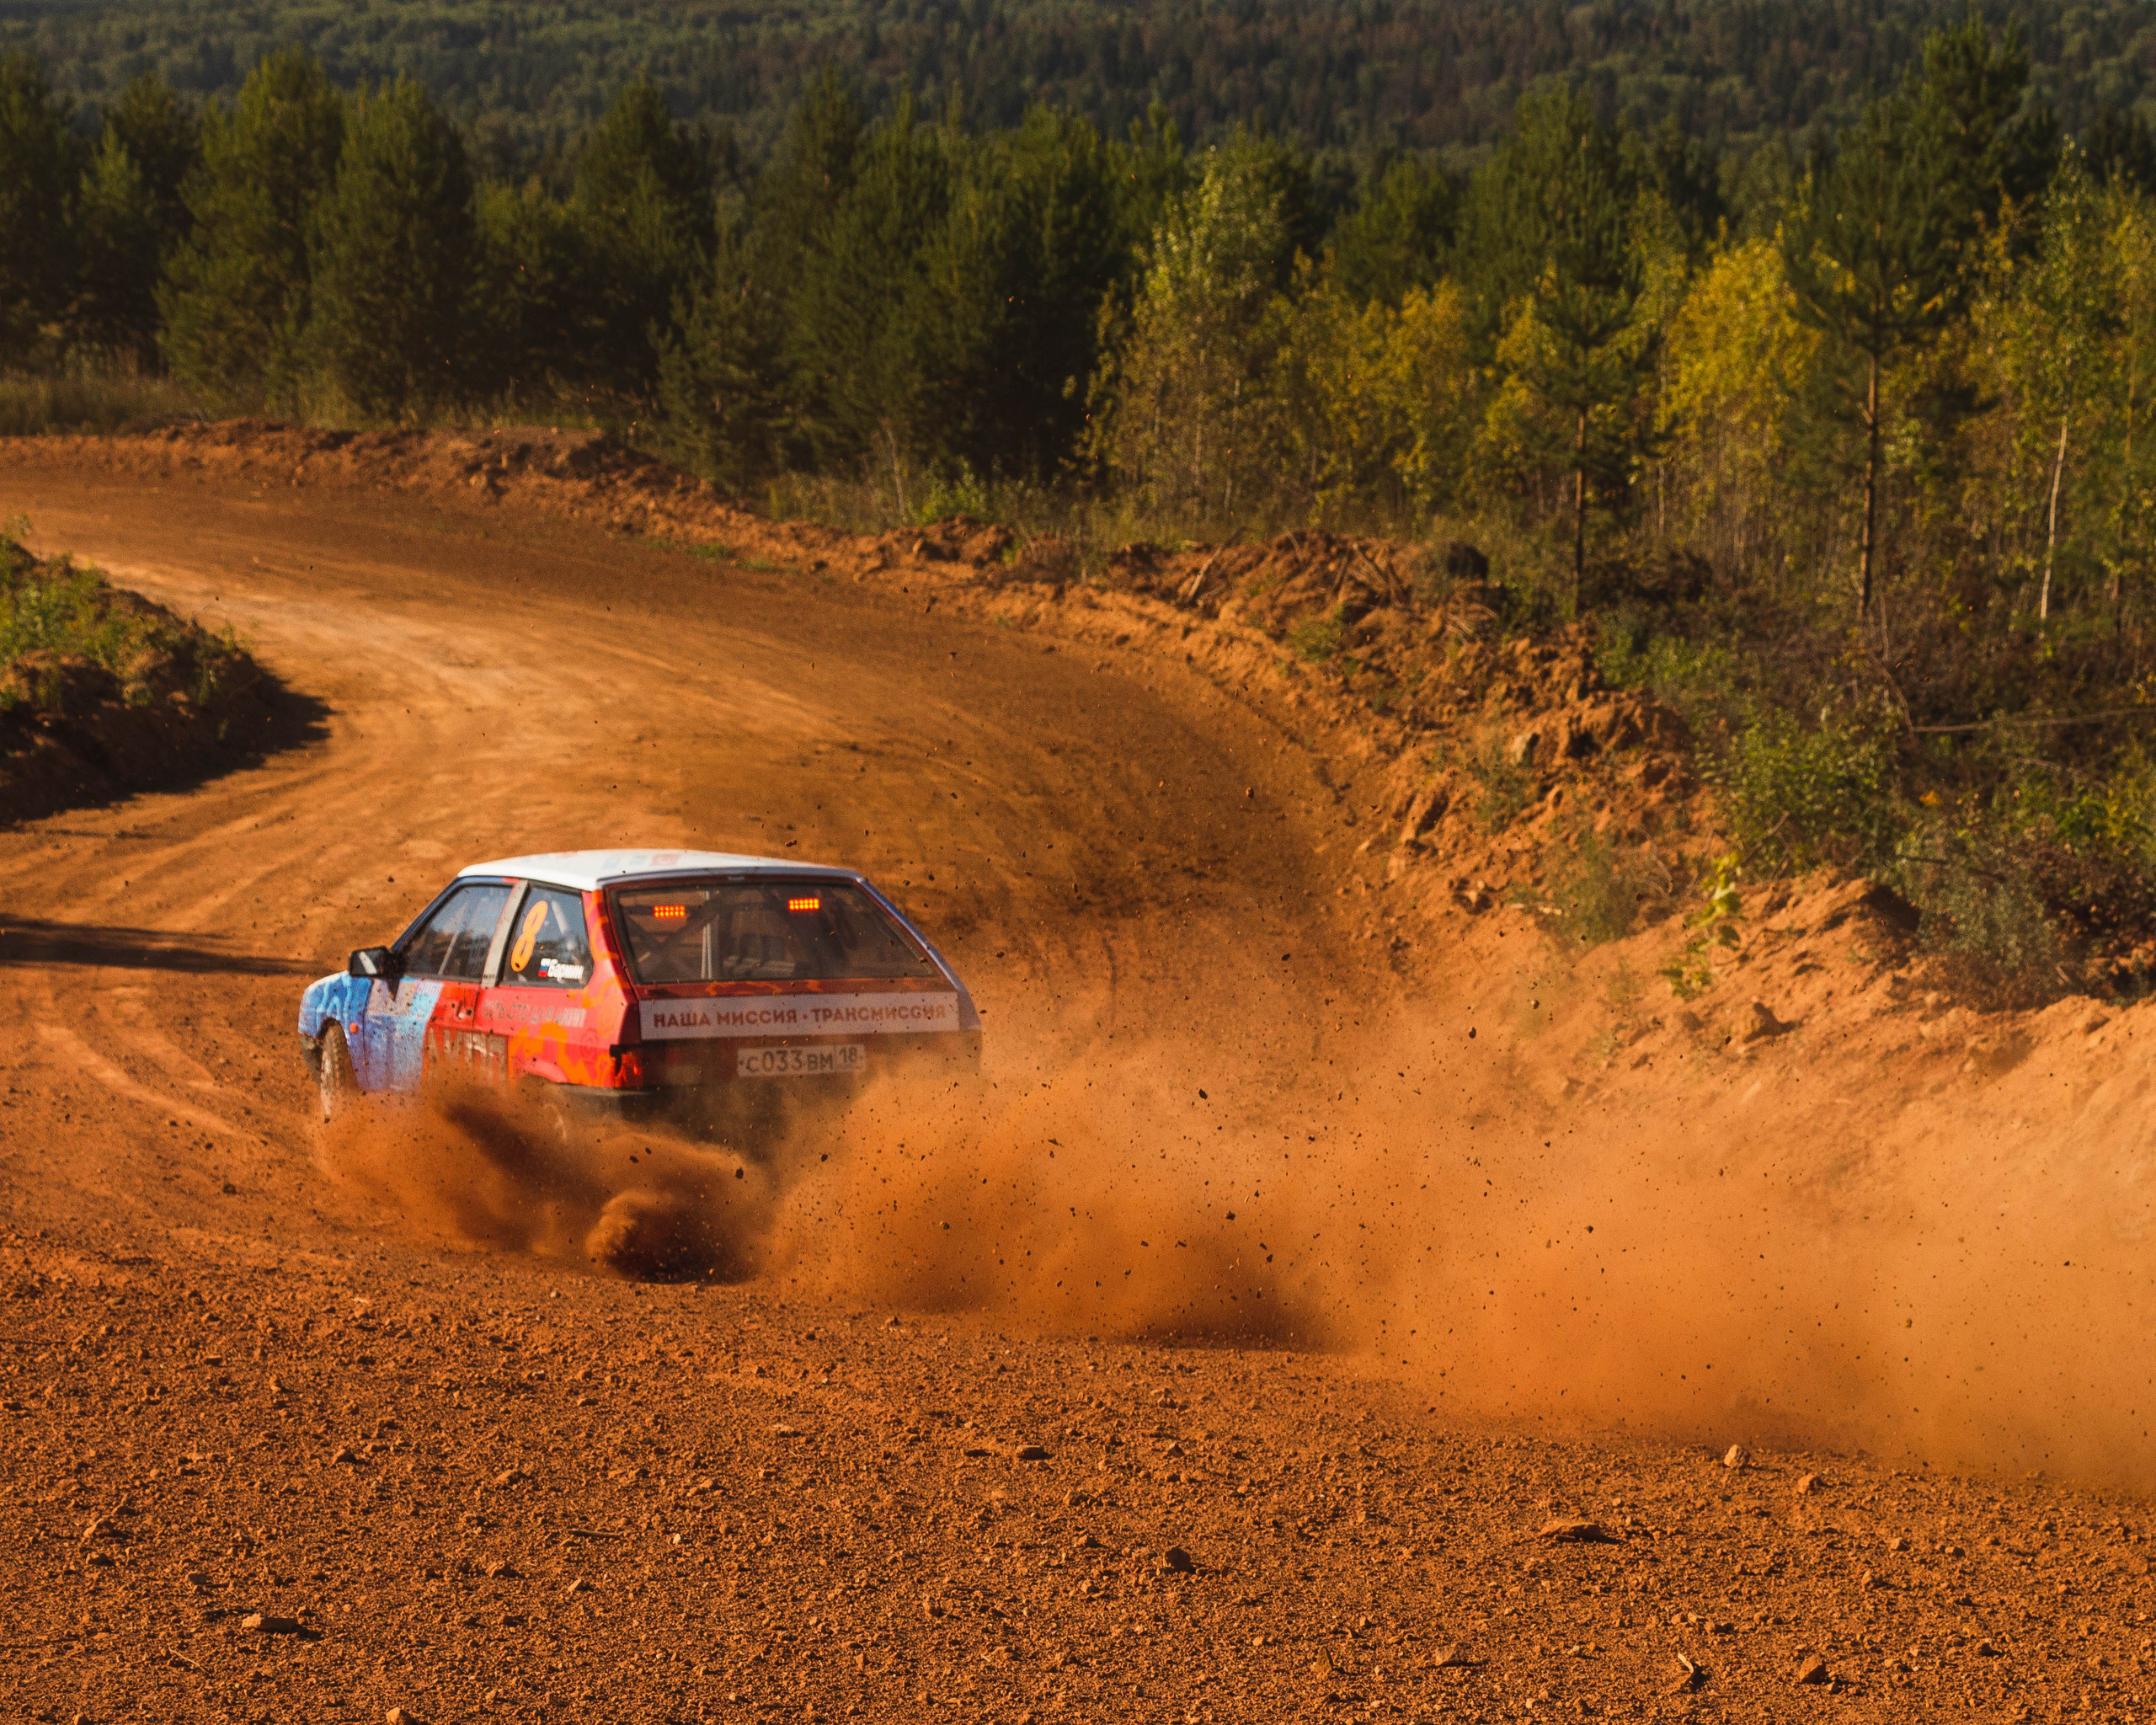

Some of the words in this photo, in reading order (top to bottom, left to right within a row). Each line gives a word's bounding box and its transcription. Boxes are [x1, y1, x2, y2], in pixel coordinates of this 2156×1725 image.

[511, 900, 548, 973] 8
[654, 1013, 711, 1028] НАША
[717, 1009, 797, 1025] МИССИЯ
[811, 1004, 947, 1022] ТРАНСМИССИЯ
[745, 1049, 834, 1073] С033ВМ
[839, 1046, 857, 1063] 18
